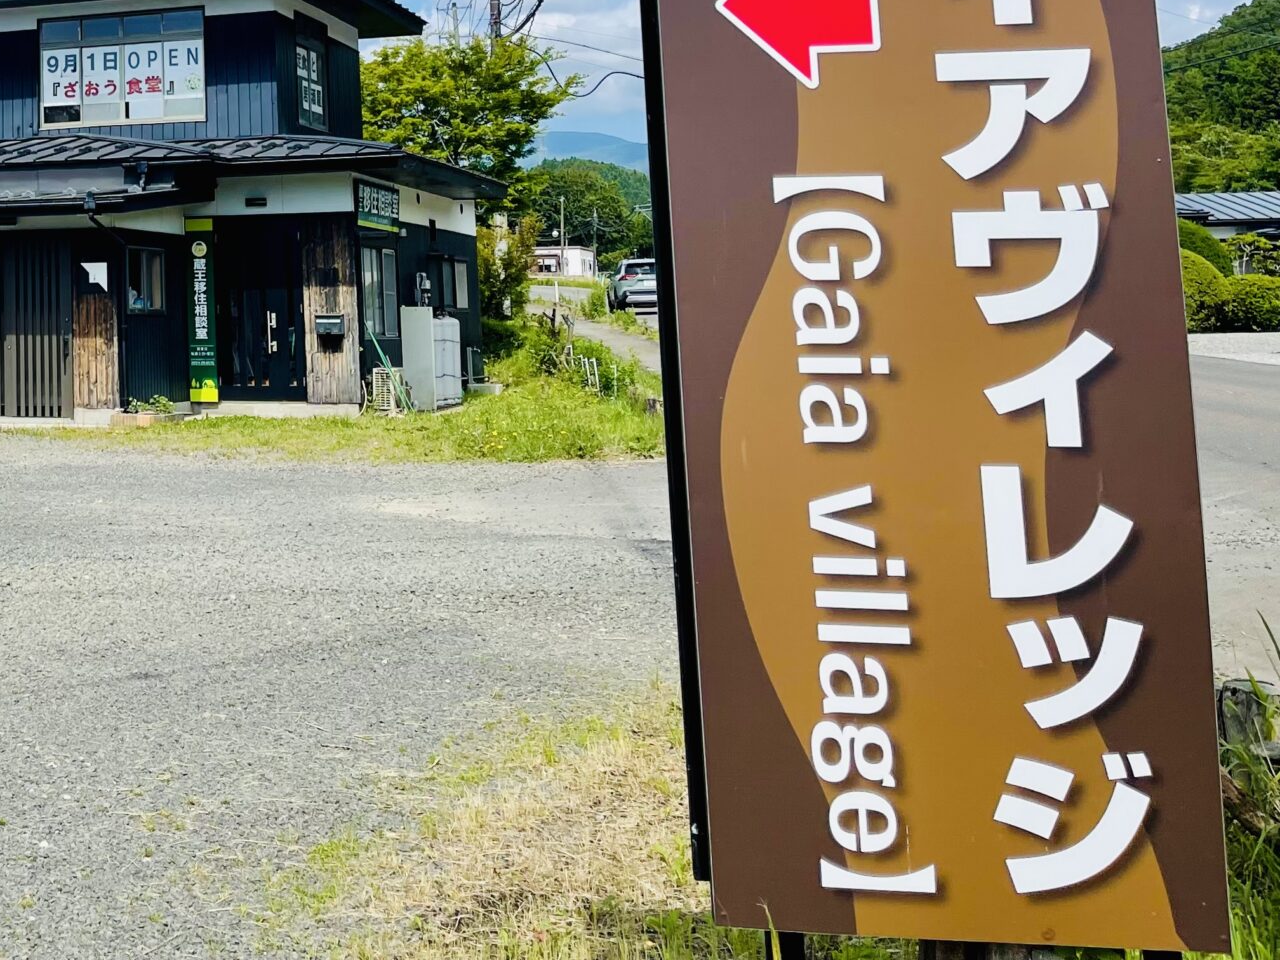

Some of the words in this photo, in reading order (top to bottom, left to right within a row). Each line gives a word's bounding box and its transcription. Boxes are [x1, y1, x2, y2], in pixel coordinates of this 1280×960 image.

[46, 51, 118, 74] 9月1日
[128, 47, 200, 70] OPEN
[193, 258, 209, 340] 蔵王移住相談室
